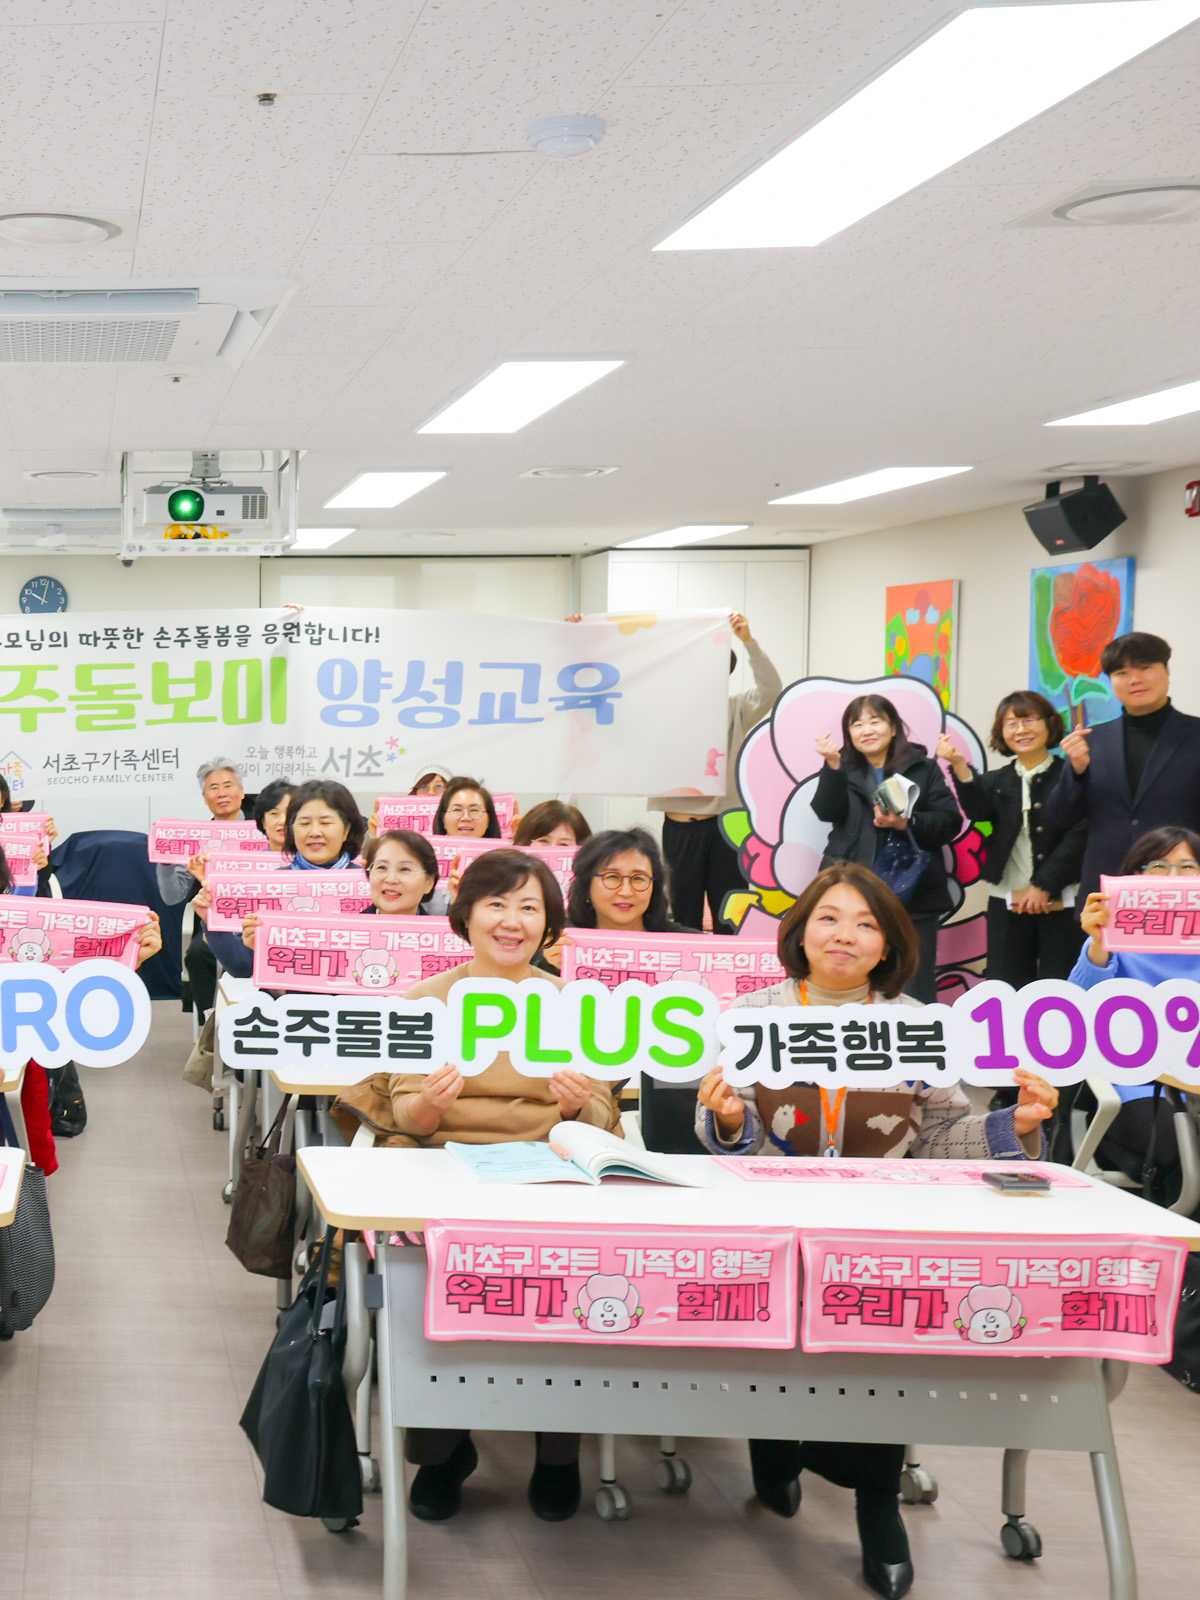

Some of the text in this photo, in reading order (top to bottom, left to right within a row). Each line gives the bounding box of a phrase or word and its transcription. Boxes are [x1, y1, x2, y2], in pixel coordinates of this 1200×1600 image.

[78, 626, 145, 650] 따뜻한
[153, 624, 252, 648] 손주돌봄을
[262, 620, 381, 645] 응원합니다!
[317, 658, 623, 728] 양성교육
[42, 746, 180, 774] 서초구가족센터
[245, 745, 318, 760] 오늘 행복하고
[320, 744, 385, 778] 서초
[47, 773, 174, 786] SEOCHO FAMILY CENTER
[237, 762, 317, 777] 일이 기다려지는
[384, 804, 417, 816] 서초구
[18, 822, 42, 832] 행복
[156, 828, 250, 840] 서초구 모든 가족의
[5, 843, 31, 856] 행복
[155, 840, 200, 856] 우리가
[216, 882, 264, 898] 서초구
[266, 883, 298, 898] 모든
[304, 882, 354, 898] 가족의
[1117, 889, 1182, 909] 서초구
[37, 912, 94, 935] 가족의
[96, 916, 136, 936] 행복
[267, 926, 328, 949] 서초구
[329, 928, 372, 950] 모든
[380, 930, 441, 953] 가족의
[267, 946, 348, 978] 우리가
[575, 946, 636, 968] 서초구
[639, 950, 682, 972] 모든
[691, 951, 757, 973] 가족의
[233, 992, 705, 1068] 손주돌봄 PLUS
[734, 1020, 947, 1073] 가족행복
[444, 1242, 775, 1280] 서초구 모든 가족의 행복
[820, 1252, 1162, 1290] 서초구 모든 가족의 행복
[446, 1274, 772, 1322] 우리가 함께!
[822, 1284, 1158, 1337] 우리가 함께!
